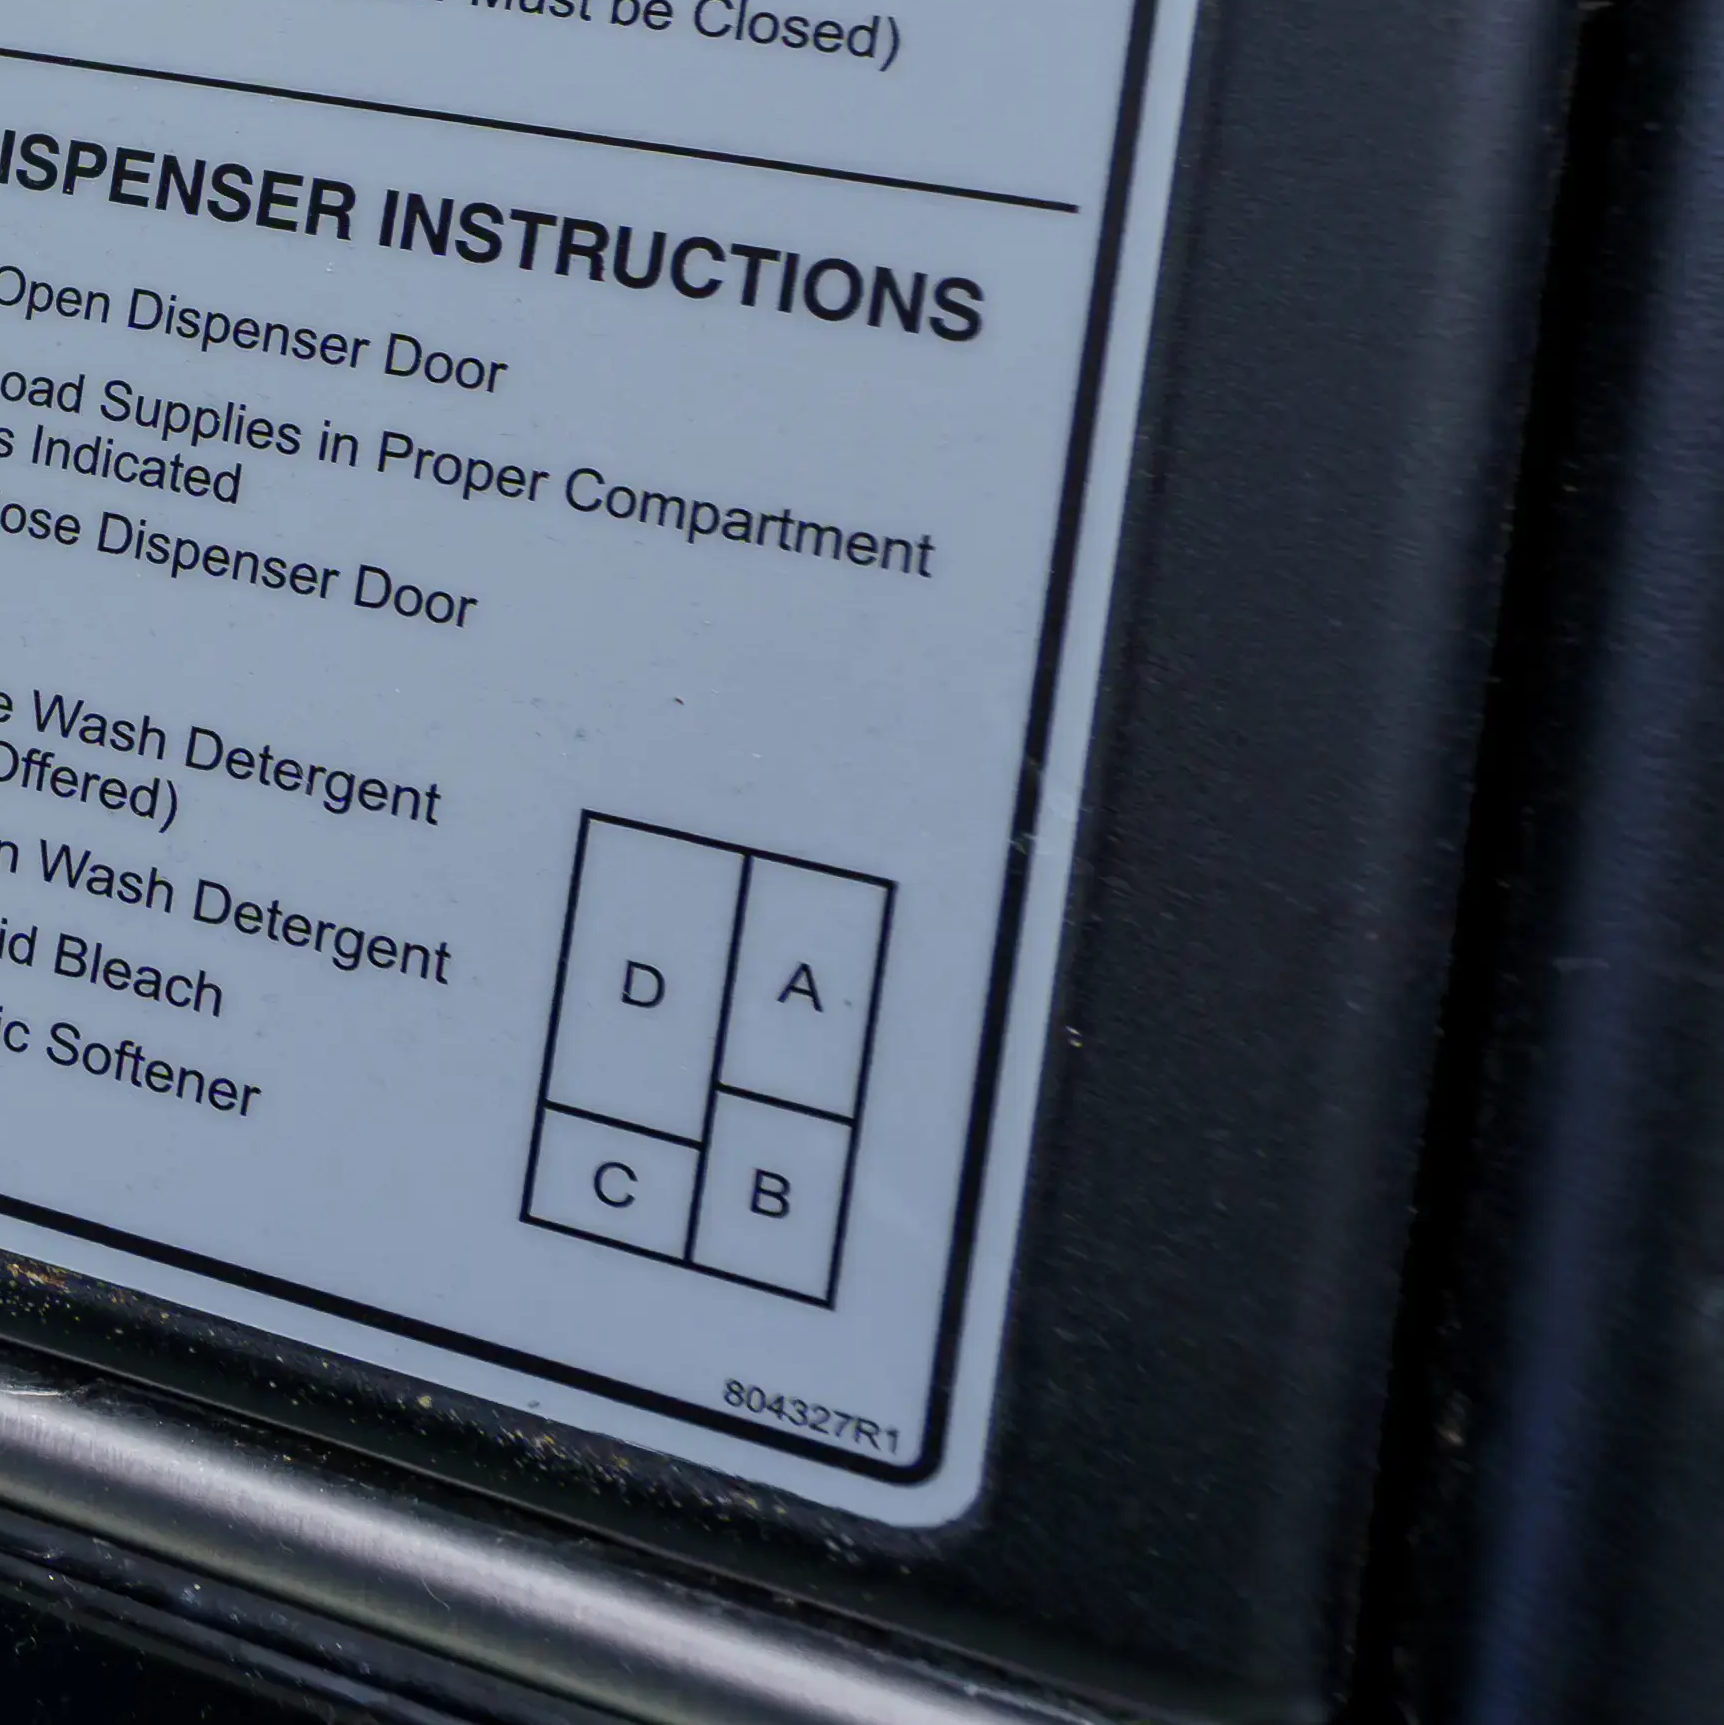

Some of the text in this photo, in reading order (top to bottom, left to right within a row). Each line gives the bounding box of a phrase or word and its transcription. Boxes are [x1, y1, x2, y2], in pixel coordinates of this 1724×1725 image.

[379, 189, 984, 342] INSTRUCTIONS
[127, 288, 371, 368] Dispenser
[384, 333, 509, 393] Door
[32, 425, 242, 504] Indicated
[100, 380, 301, 455] Supplies
[319, 420, 359, 467] in
[377, 431, 550, 501] Proper
[565, 468, 936, 578] Compartment
[97, 512, 340, 599] Dispenser
[354, 564, 479, 628] Door
[33, 689, 166, 760] Wash
[185, 726, 442, 826] Detergent
[40, 839, 173, 913] Wash
[193, 879, 452, 985] Detergent
[54, 933, 222, 1018] Bleach
[621, 959, 666, 1009] D
[776, 962, 824, 1013] A
[46, 1022, 262, 1116] Softener
[593, 1161, 638, 1208] C
[749, 1168, 791, 1219] B
[723, 1377, 902, 1456] 804327R1
